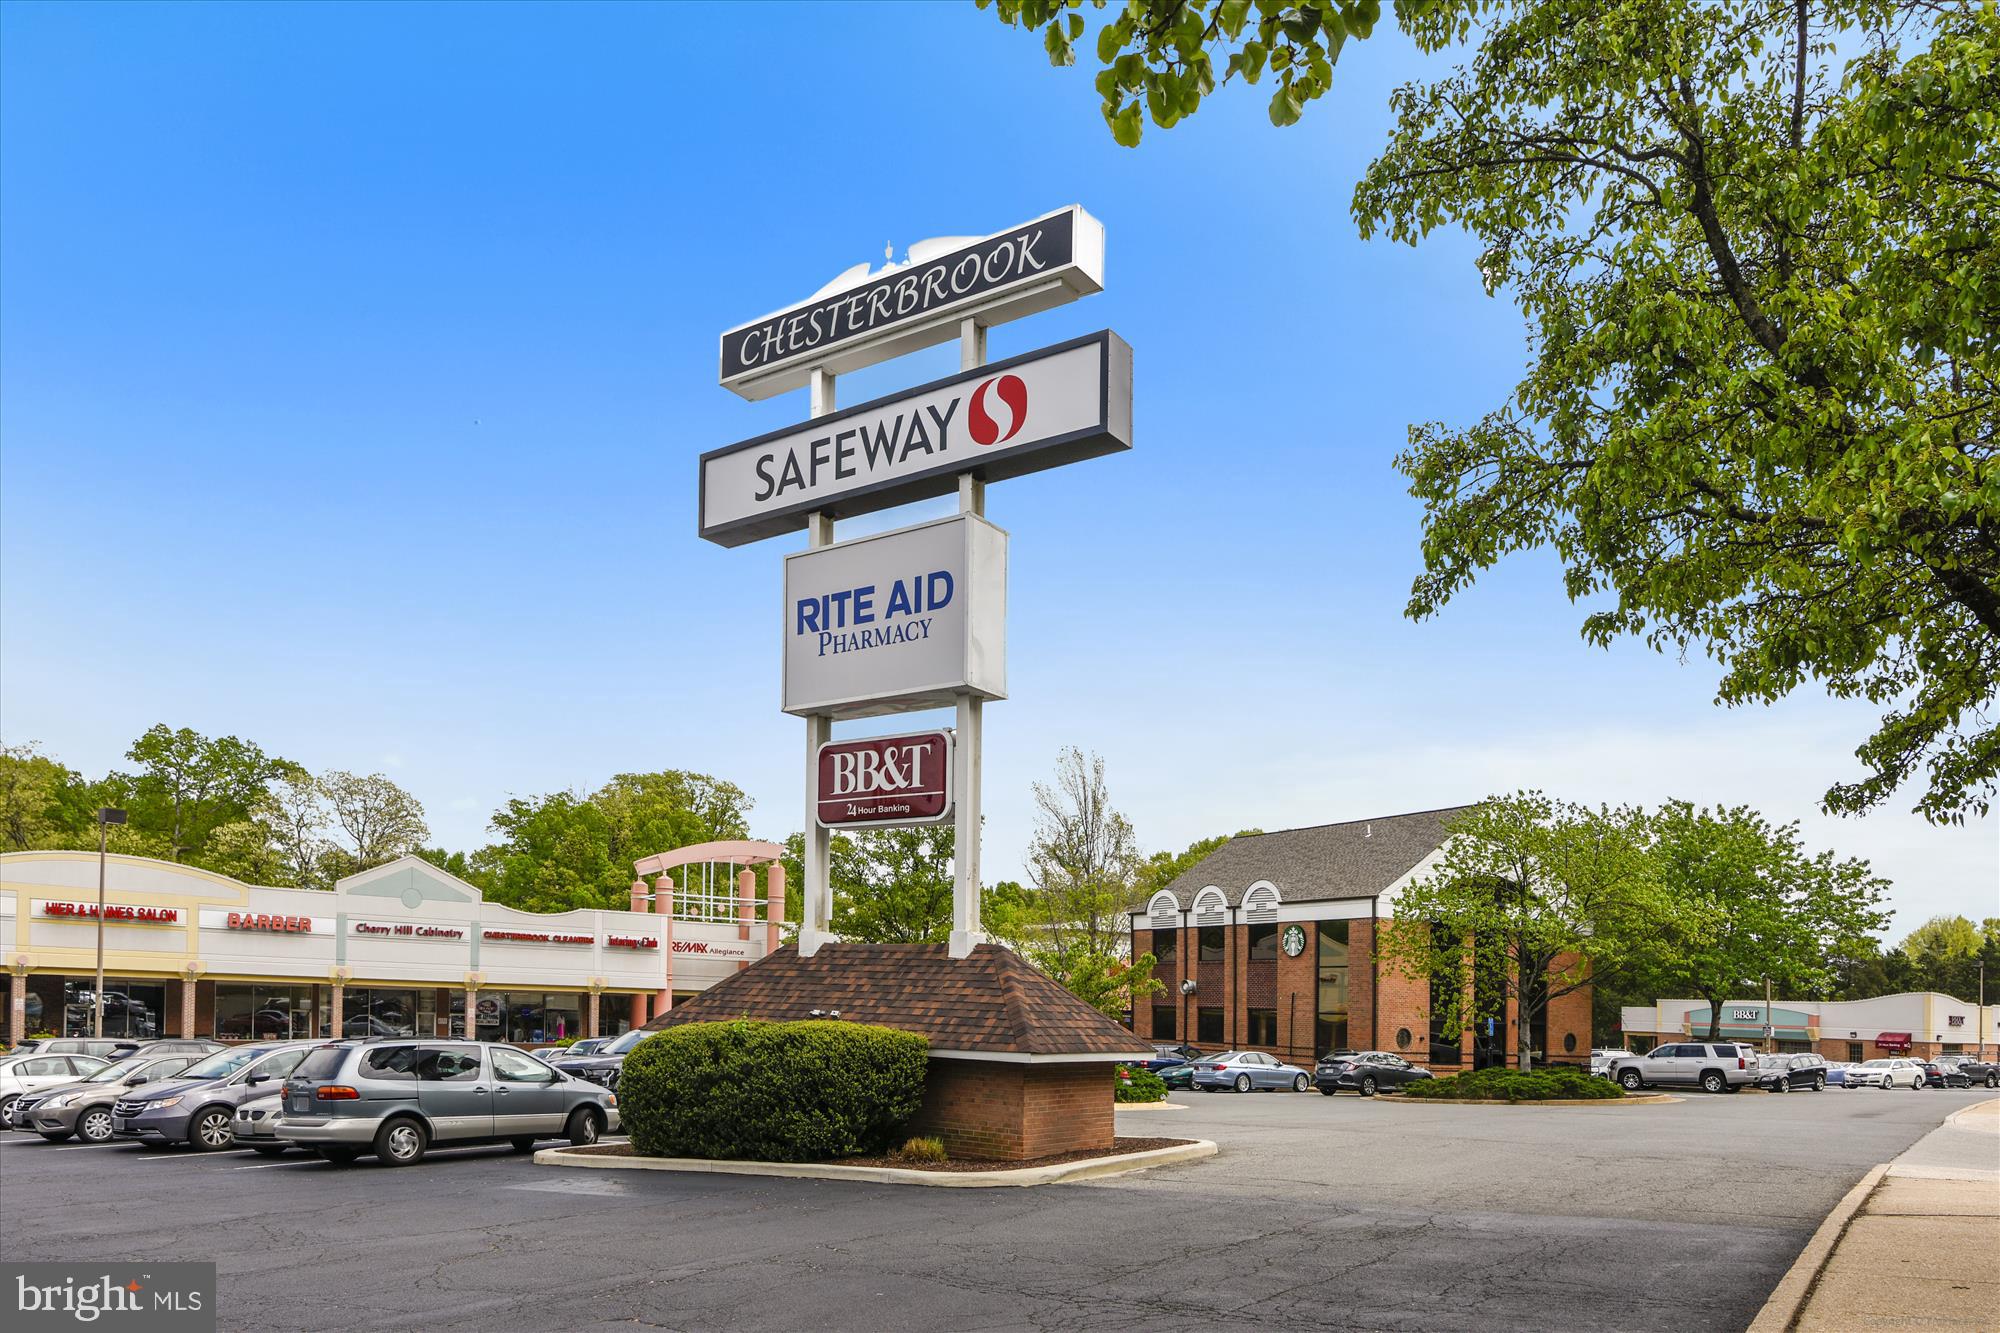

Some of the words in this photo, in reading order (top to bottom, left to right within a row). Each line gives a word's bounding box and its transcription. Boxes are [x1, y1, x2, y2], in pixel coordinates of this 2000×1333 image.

[739, 230, 1046, 367] CHESTERBROOK
[754, 397, 961, 502] SAFEWAY
[797, 585, 875, 636] RITE
[885, 570, 955, 619] AID
[829, 743, 931, 796] BB&T
[847, 803, 857, 817] 24
[857, 806, 877, 815] Hour
[878, 803, 910, 813] Banking
[78, 904, 86, 917] &
[137, 907, 177, 922] SALON
[228, 912, 312, 932] BARBER
[355, 923, 391, 936] Cherry
[394, 925, 413, 935] Hill
[415, 926, 464, 940] Cabinetry
[672, 941, 708, 953] RE/MAX
[709, 947, 745, 957] Allegiance
[1733, 1010, 1758, 1020] BB&T
